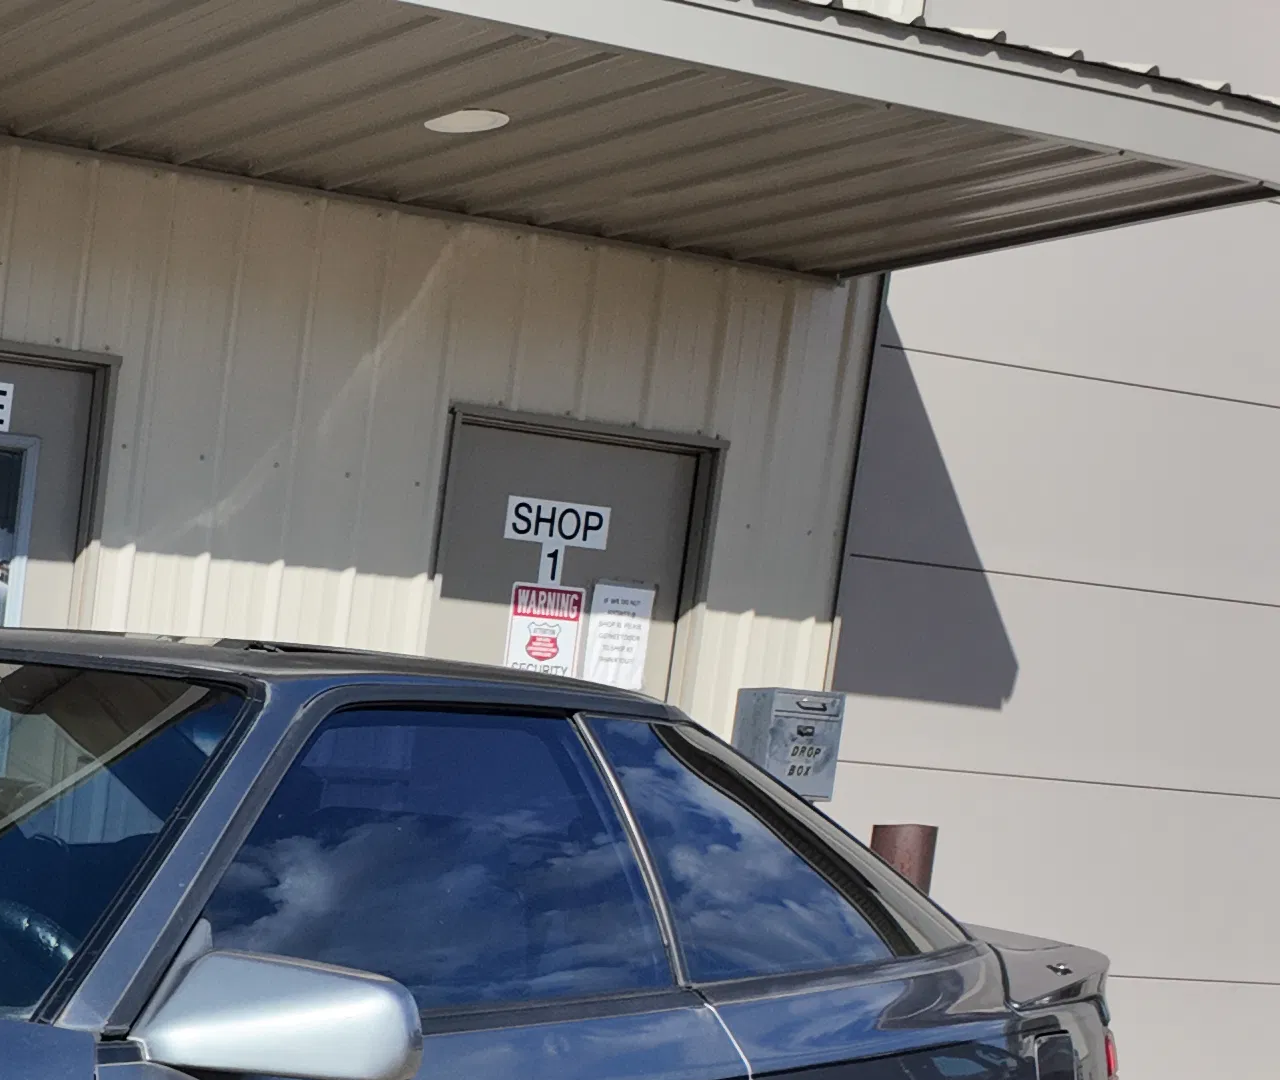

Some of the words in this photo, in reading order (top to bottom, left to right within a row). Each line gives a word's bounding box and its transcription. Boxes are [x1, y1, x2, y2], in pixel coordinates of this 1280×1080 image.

[511, 502, 604, 542] SHOP
[546, 548, 559, 581] 1
[516, 588, 579, 620] WARNING
[790, 745, 822, 758] DROP
[787, 764, 812, 777] BOX
